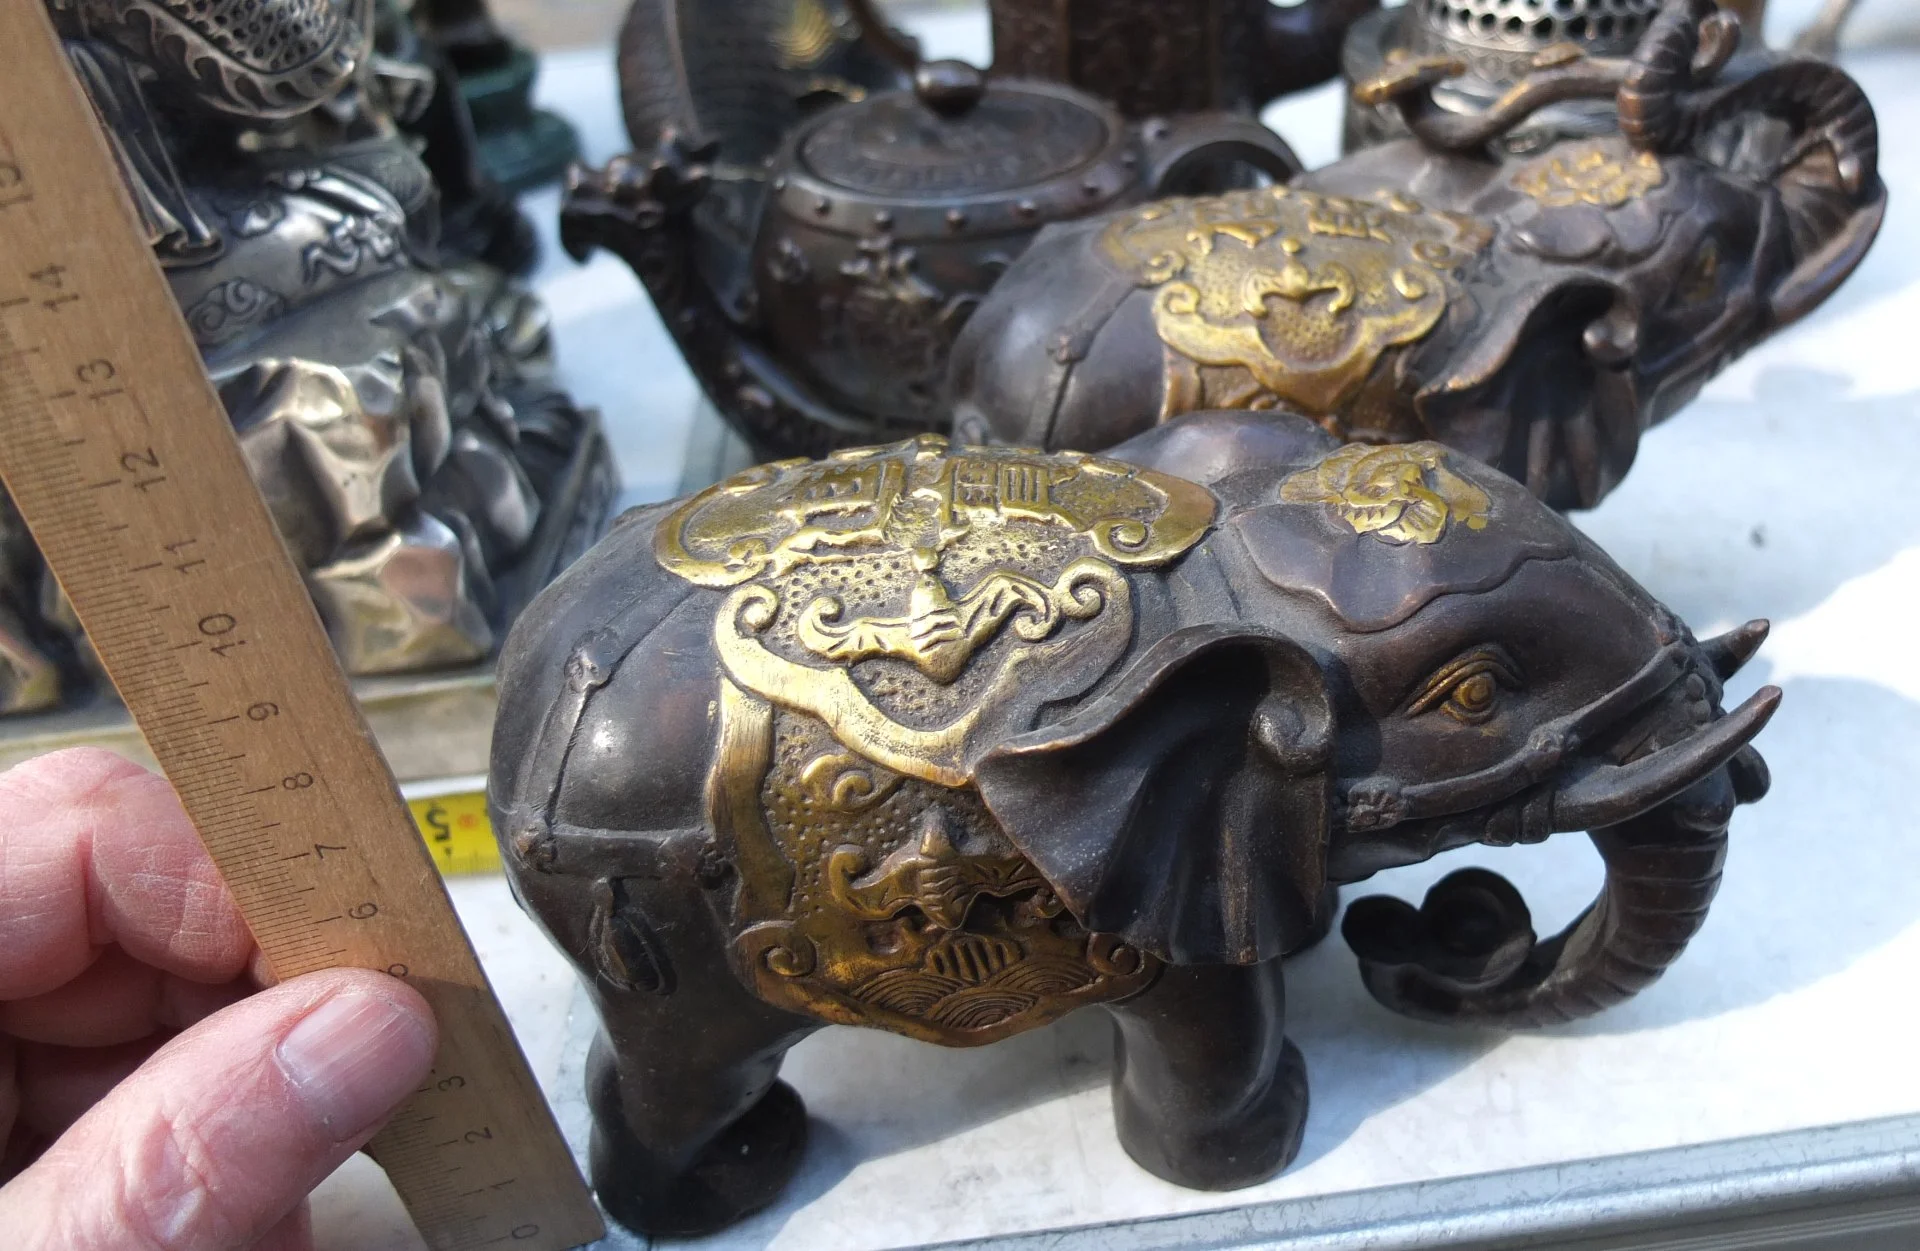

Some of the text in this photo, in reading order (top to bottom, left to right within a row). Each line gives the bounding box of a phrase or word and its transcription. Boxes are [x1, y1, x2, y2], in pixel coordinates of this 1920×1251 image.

[29, 262, 80, 311] 14
[76, 356, 123, 404] 13
[120, 447, 167, 492] 12
[163, 538, 206, 574] 11
[198, 612, 247, 657] 10
[247, 701, 280, 721] 9
[282, 772, 314, 791] 8
[314, 842, 347, 860] 7
[348, 902, 379, 920] 6
[437, 1075, 467, 1093] 3
[464, 1126, 493, 1144] 2
[489, 1178, 516, 1191] 1
[511, 1223, 540, 1240] 0
